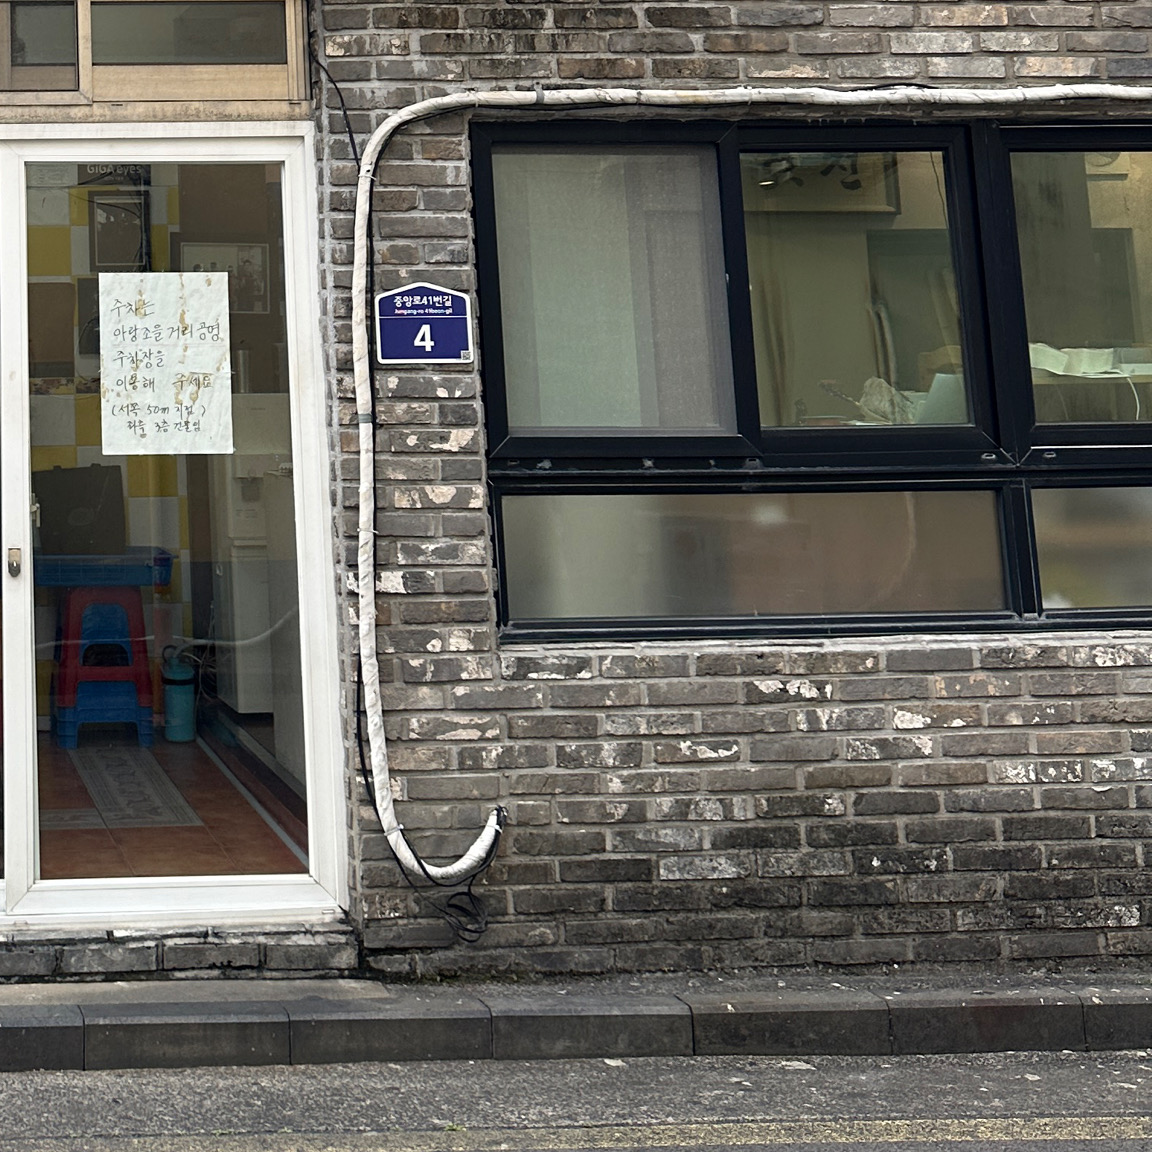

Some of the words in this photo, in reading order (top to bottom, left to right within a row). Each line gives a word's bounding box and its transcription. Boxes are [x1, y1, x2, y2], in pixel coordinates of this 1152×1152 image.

[110, 298, 155, 317] 주차는
[393, 295, 453, 307] 중앙로41번길
[413, 324, 435, 352] 4
